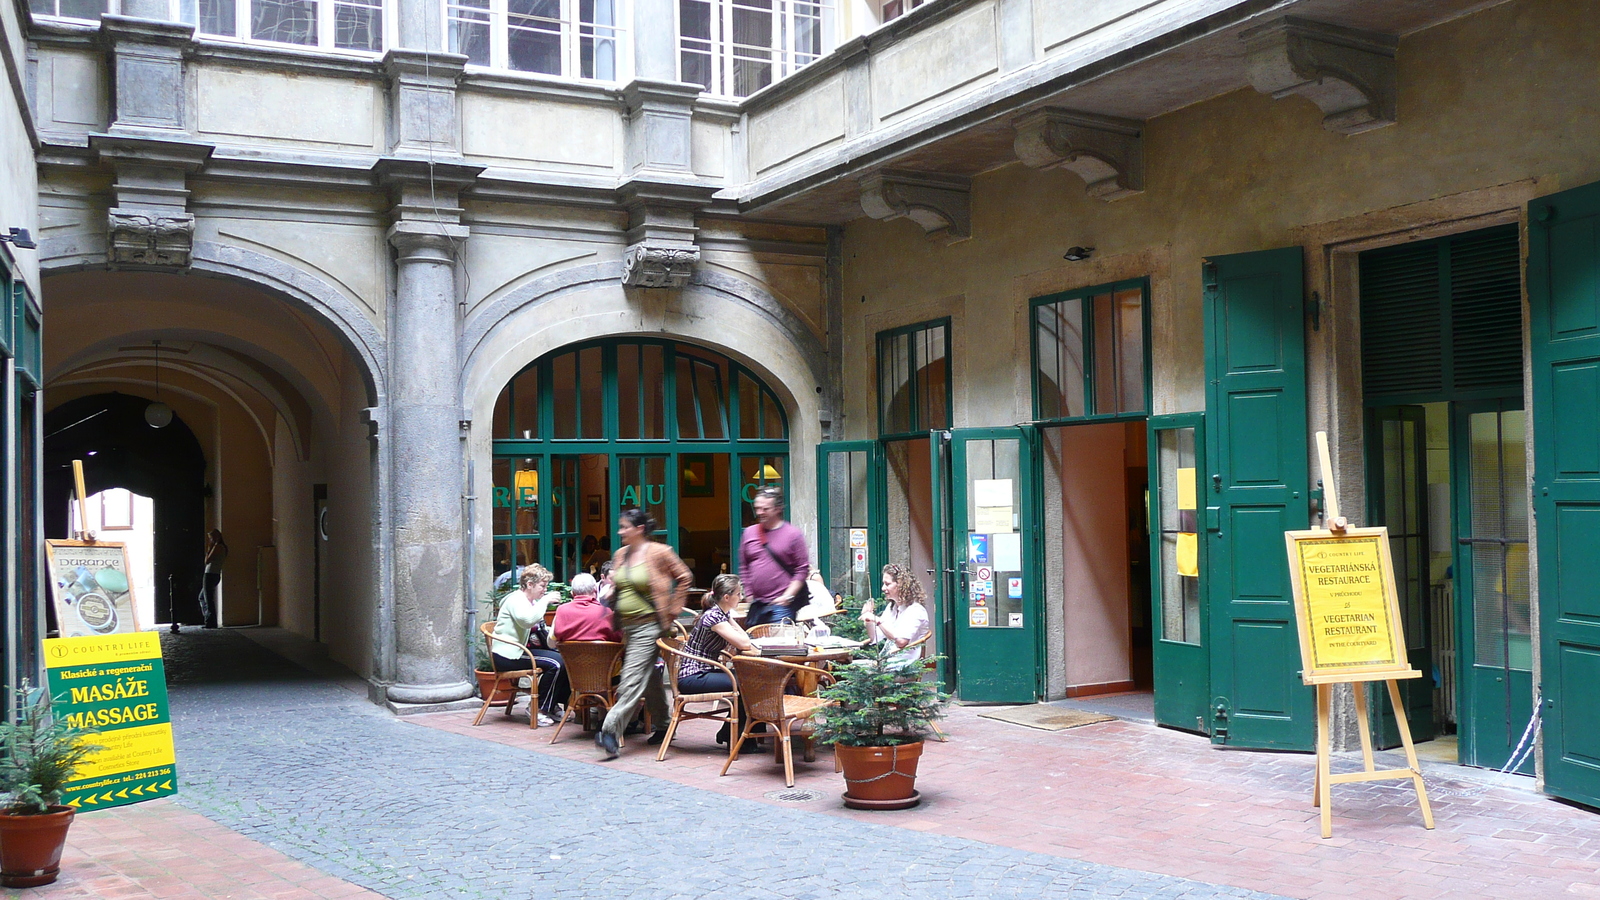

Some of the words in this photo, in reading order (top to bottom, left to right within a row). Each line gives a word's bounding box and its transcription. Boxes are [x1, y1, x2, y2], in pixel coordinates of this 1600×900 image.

[1309, 561, 1376, 574] VEGETARIÁNSKÁ
[1318, 575, 1371, 586] RESTAURACE
[1323, 613, 1375, 623] VEGETARIAN
[1324, 625, 1378, 636] RESTAURANT
[73, 643, 125, 654] COUNTRY
[128, 641, 151, 650] LIFE
[60, 668, 97, 680] Klasické
[106, 663, 153, 677] regenerační
[70, 676, 149, 705] MASÁŽE
[67, 703, 159, 730] MASSAGE
[123, 741, 133, 749] Life
[103, 754, 126, 763] available
[132, 749, 152, 758] Country
[153, 747, 163, 755] Life
[98, 761, 126, 771] Cosmetics
[126, 759, 140, 767] Store
[66, 778, 121, 792] www.countrylife.cz
[135, 772, 147, 780] 224
[147, 770, 159, 778] 213
[160, 768, 171, 776] 366
